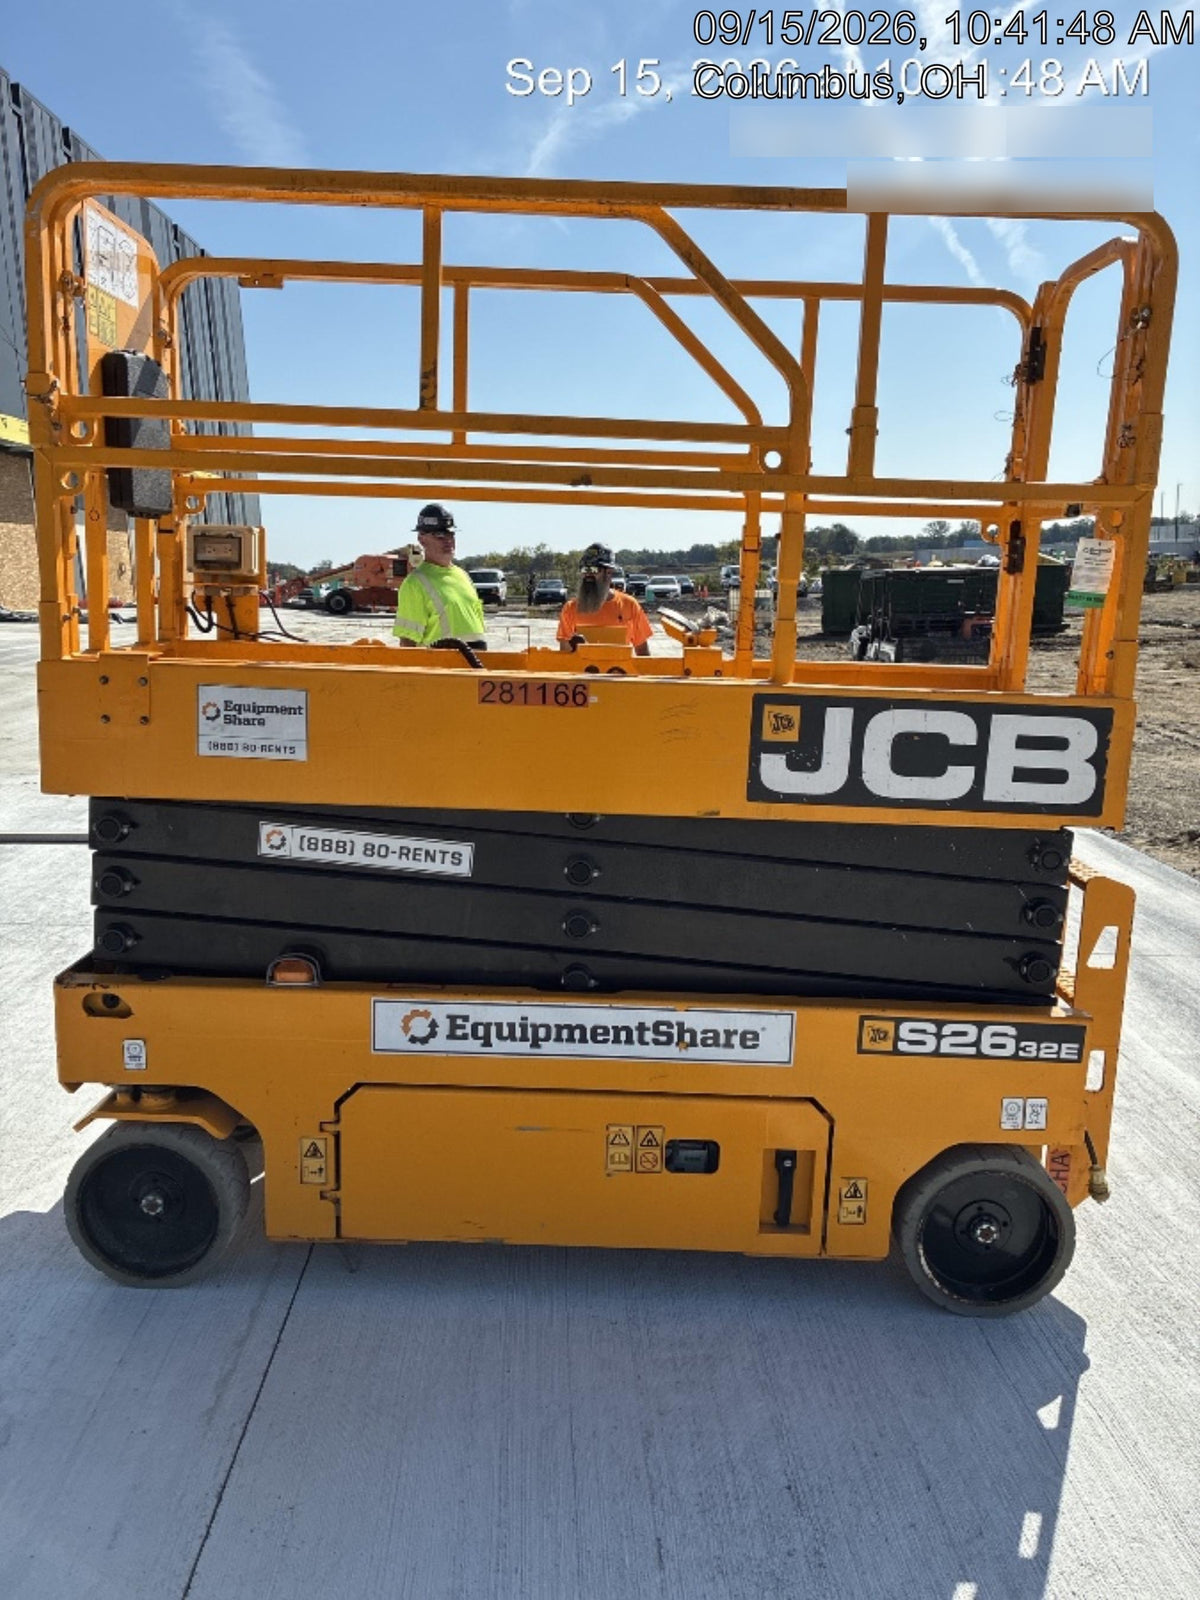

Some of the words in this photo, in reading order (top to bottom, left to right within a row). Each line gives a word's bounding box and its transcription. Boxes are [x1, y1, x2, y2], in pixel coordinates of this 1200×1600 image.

[480, 679, 589, 707] 281166
[223, 700, 304, 716] Equipment
[223, 714, 266, 727] Share
[758, 706, 1099, 805] JCB
[362, 842, 464, 867] 80-RENTS
[445, 1013, 761, 1050] EquipmentShare
[897, 1020, 1018, 1058] S26
[1018, 1040, 1080, 1060] 32E
